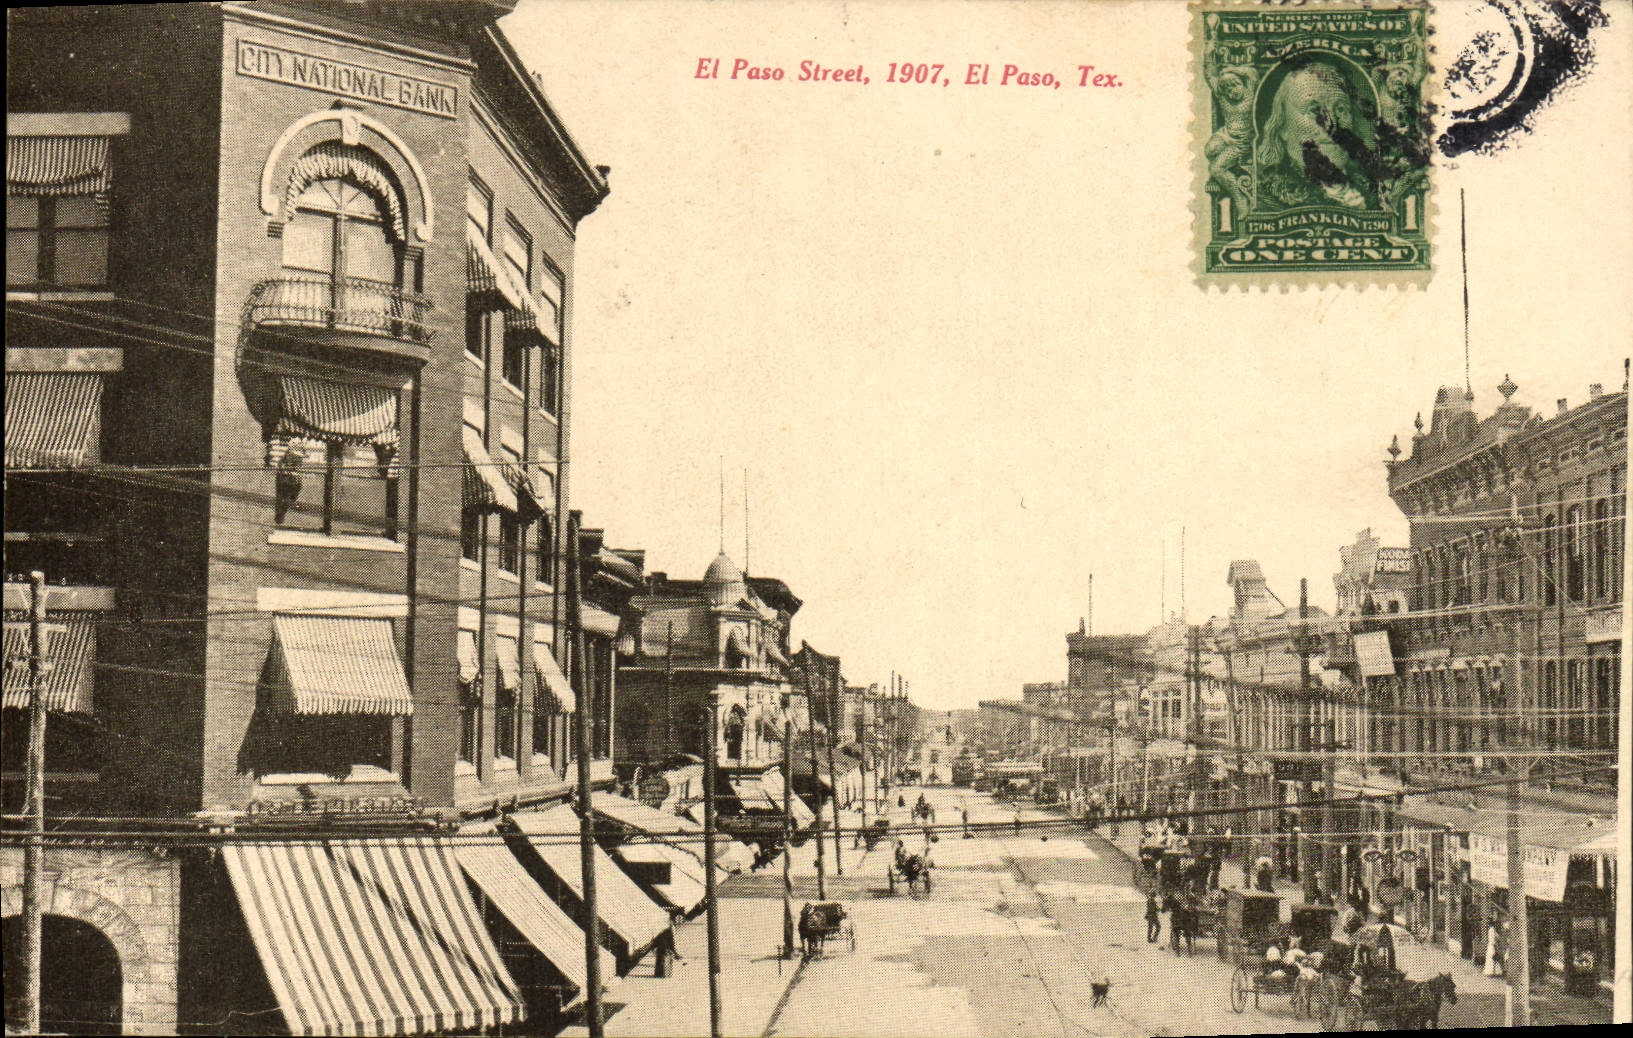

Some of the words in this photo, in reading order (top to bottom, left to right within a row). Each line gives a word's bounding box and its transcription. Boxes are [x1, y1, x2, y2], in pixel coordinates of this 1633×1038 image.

[1222, 21, 1296, 33] UNITED
[1298, 20, 1377, 32] STATES
[1379, 20, 1408, 31] OF
[1261, 38, 1372, 58] AMERICA
[240, 47, 284, 78] CITY
[293, 58, 395, 101] NATIONAL
[399, 83, 454, 112] BANK
[1217, 197, 1232, 232] 1
[1249, 221, 1276, 232] 1706
[1278, 212, 1362, 230] FRANKLIN
[1362, 220, 1389, 231] 1790
[1403, 194, 1419, 230] 1
[1257, 238, 1380, 248] POSTAGE
[1229, 250, 1306, 261] ONE
[1311, 248, 1409, 261] CENT
